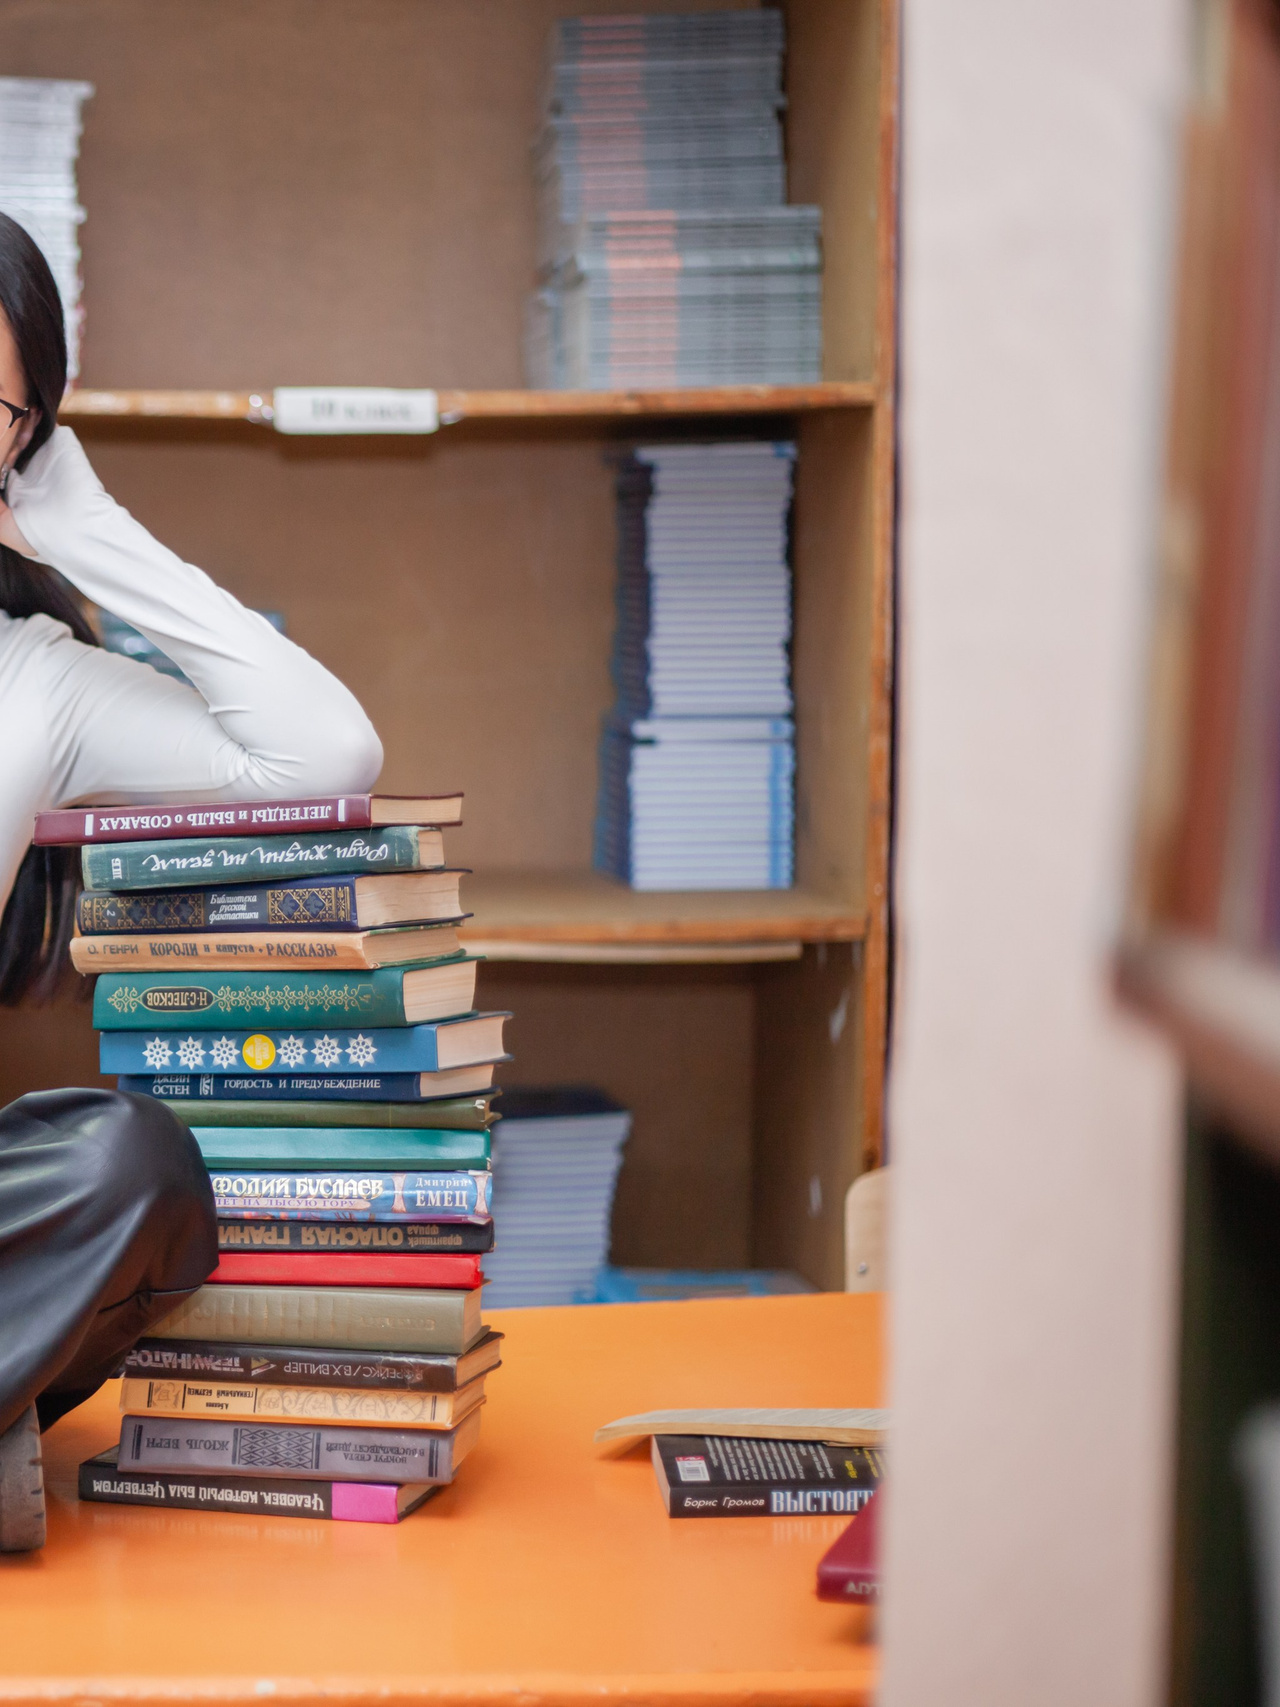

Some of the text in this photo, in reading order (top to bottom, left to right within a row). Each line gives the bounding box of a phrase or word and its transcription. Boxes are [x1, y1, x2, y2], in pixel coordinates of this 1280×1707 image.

[99, 805, 332, 831] ЛЕГЕНДЫ и БЫЛЬ о СОБАКАХ
[209, 893, 258, 905] Библиотека
[219, 902, 247, 912] русской
[208, 910, 259, 922] фантастики
[87, 943, 139, 955] О. ГЕНРИ
[149, 942, 338, 958] КОРОЛИ и капуста РАССКАЗЫ
[152, 1084, 190, 1095] ОСТЕН
[223, 1078, 381, 1090] ГОРДОСТЬ И ПРЕДУБЕЖДЕНИЕ
[295, 1177, 384, 1200] БУСЛАЕВ
[415, 1177, 469, 1188] Дмитрий
[243, 1198, 261, 1206] НА
[264, 1198, 319, 1207] ЛЫСУЮ
[322, 1199, 356, 1208] ГОРУ
[415, 1191, 468, 1210] ЕМЕЦ
[217, 1225, 404, 1246] ОПАСНАЯ ГРАНИ
[146, 1437, 231, 1451] ЖЮЛЬ ВЕРН
[325, 1441, 352, 1453] ДНЕЙ
[343, 1452, 407, 1464] ВОКРУГ СВЕТА
[92, 1479, 166, 1499] ЧЕТВЕРГОМ
[168, 1484, 196, 1498] БЫЛ
[199, 1486, 258, 1504] КОТОРЫЙ
[683, 1497, 718, 1508] Борис
[722, 1497, 766, 1508] Громов
